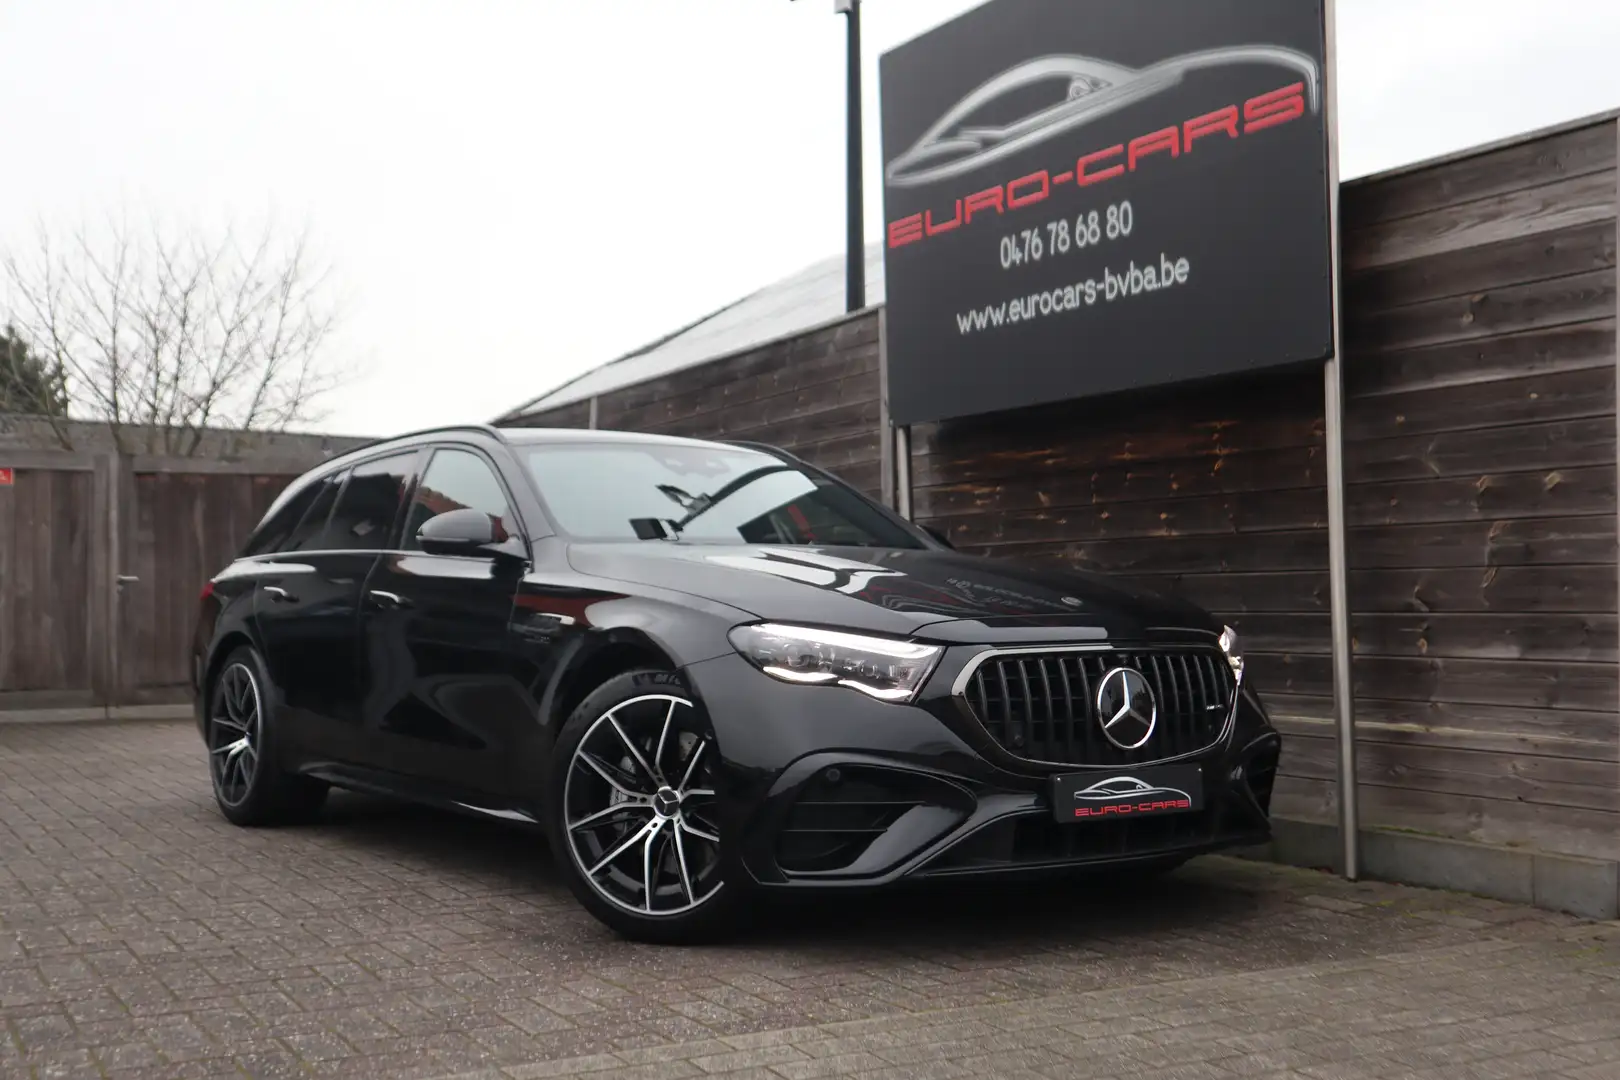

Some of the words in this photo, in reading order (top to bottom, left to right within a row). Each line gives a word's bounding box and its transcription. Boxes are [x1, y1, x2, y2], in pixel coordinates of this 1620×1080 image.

[888, 82, 1305, 248] EURO-CARS
[1000, 228, 1043, 268] 0476
[1047, 219, 1070, 254] 78
[1076, 211, 1101, 248] 68
[1106, 201, 1133, 239] 80
[956, 253, 1190, 334] www.eurocars-bvba.be
[1074, 799, 1191, 817] EURO-CARS
